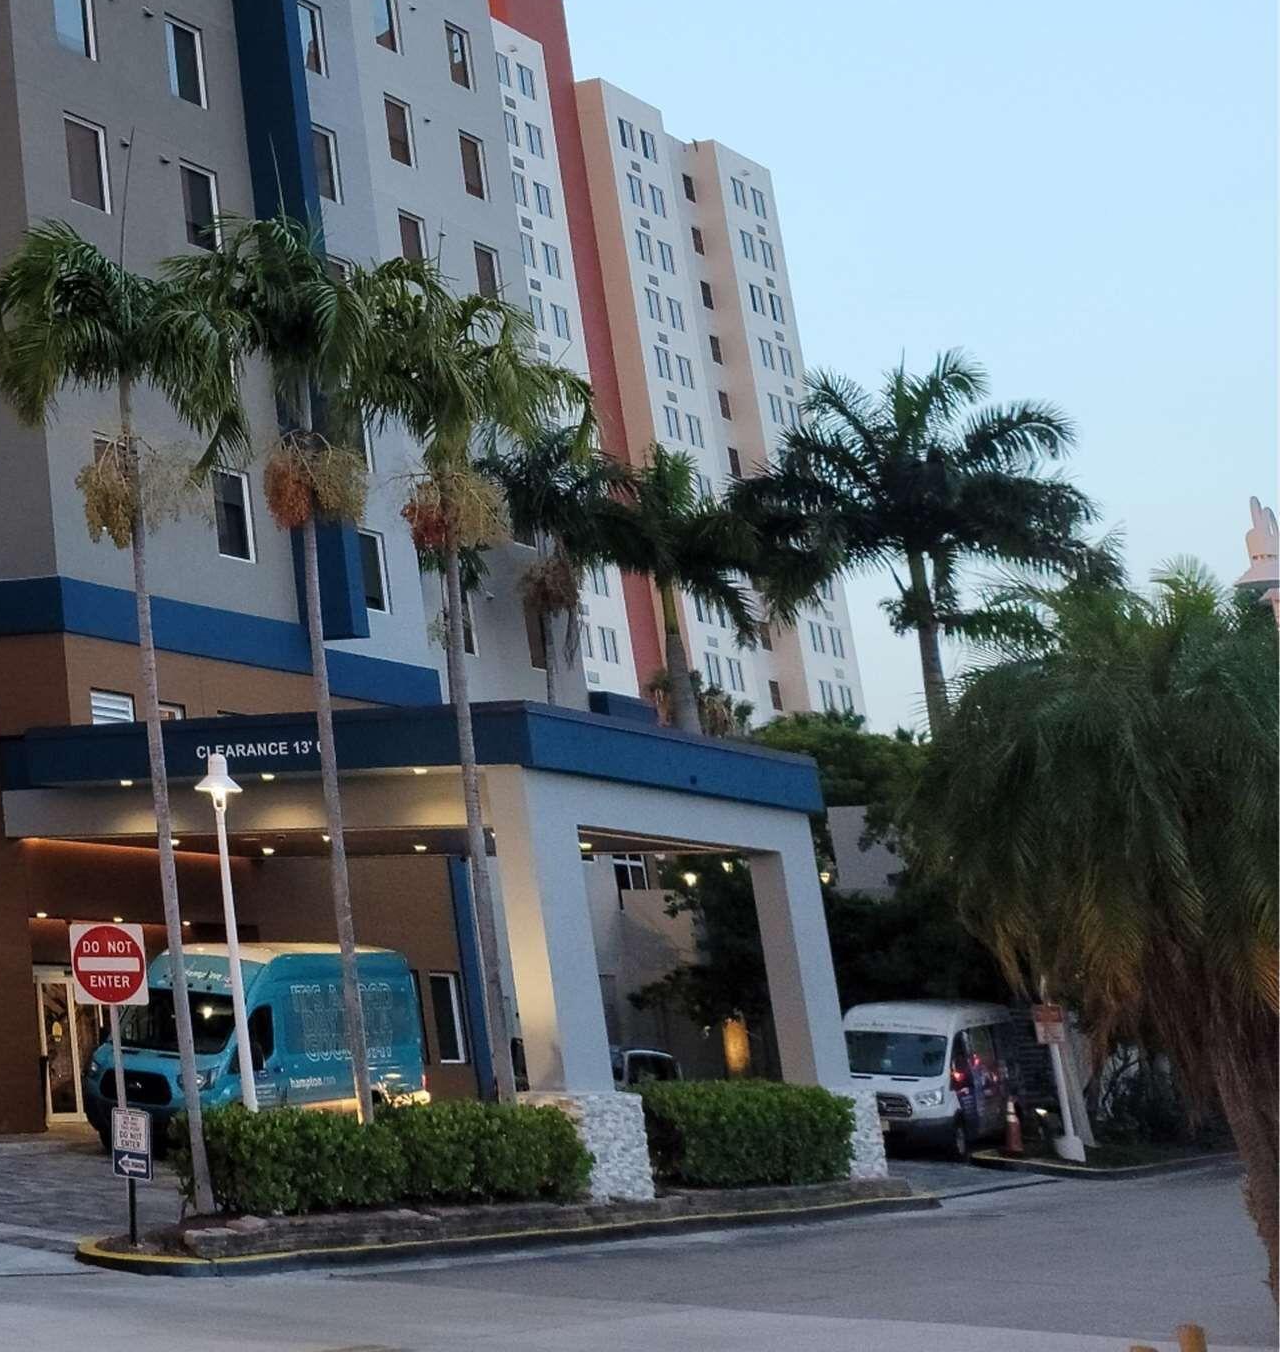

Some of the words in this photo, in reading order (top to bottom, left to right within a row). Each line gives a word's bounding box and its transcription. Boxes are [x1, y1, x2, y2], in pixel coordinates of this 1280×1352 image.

[82, 940, 100, 953] DO
[107, 940, 132, 953] NOT
[89, 975, 131, 988] ENTER
